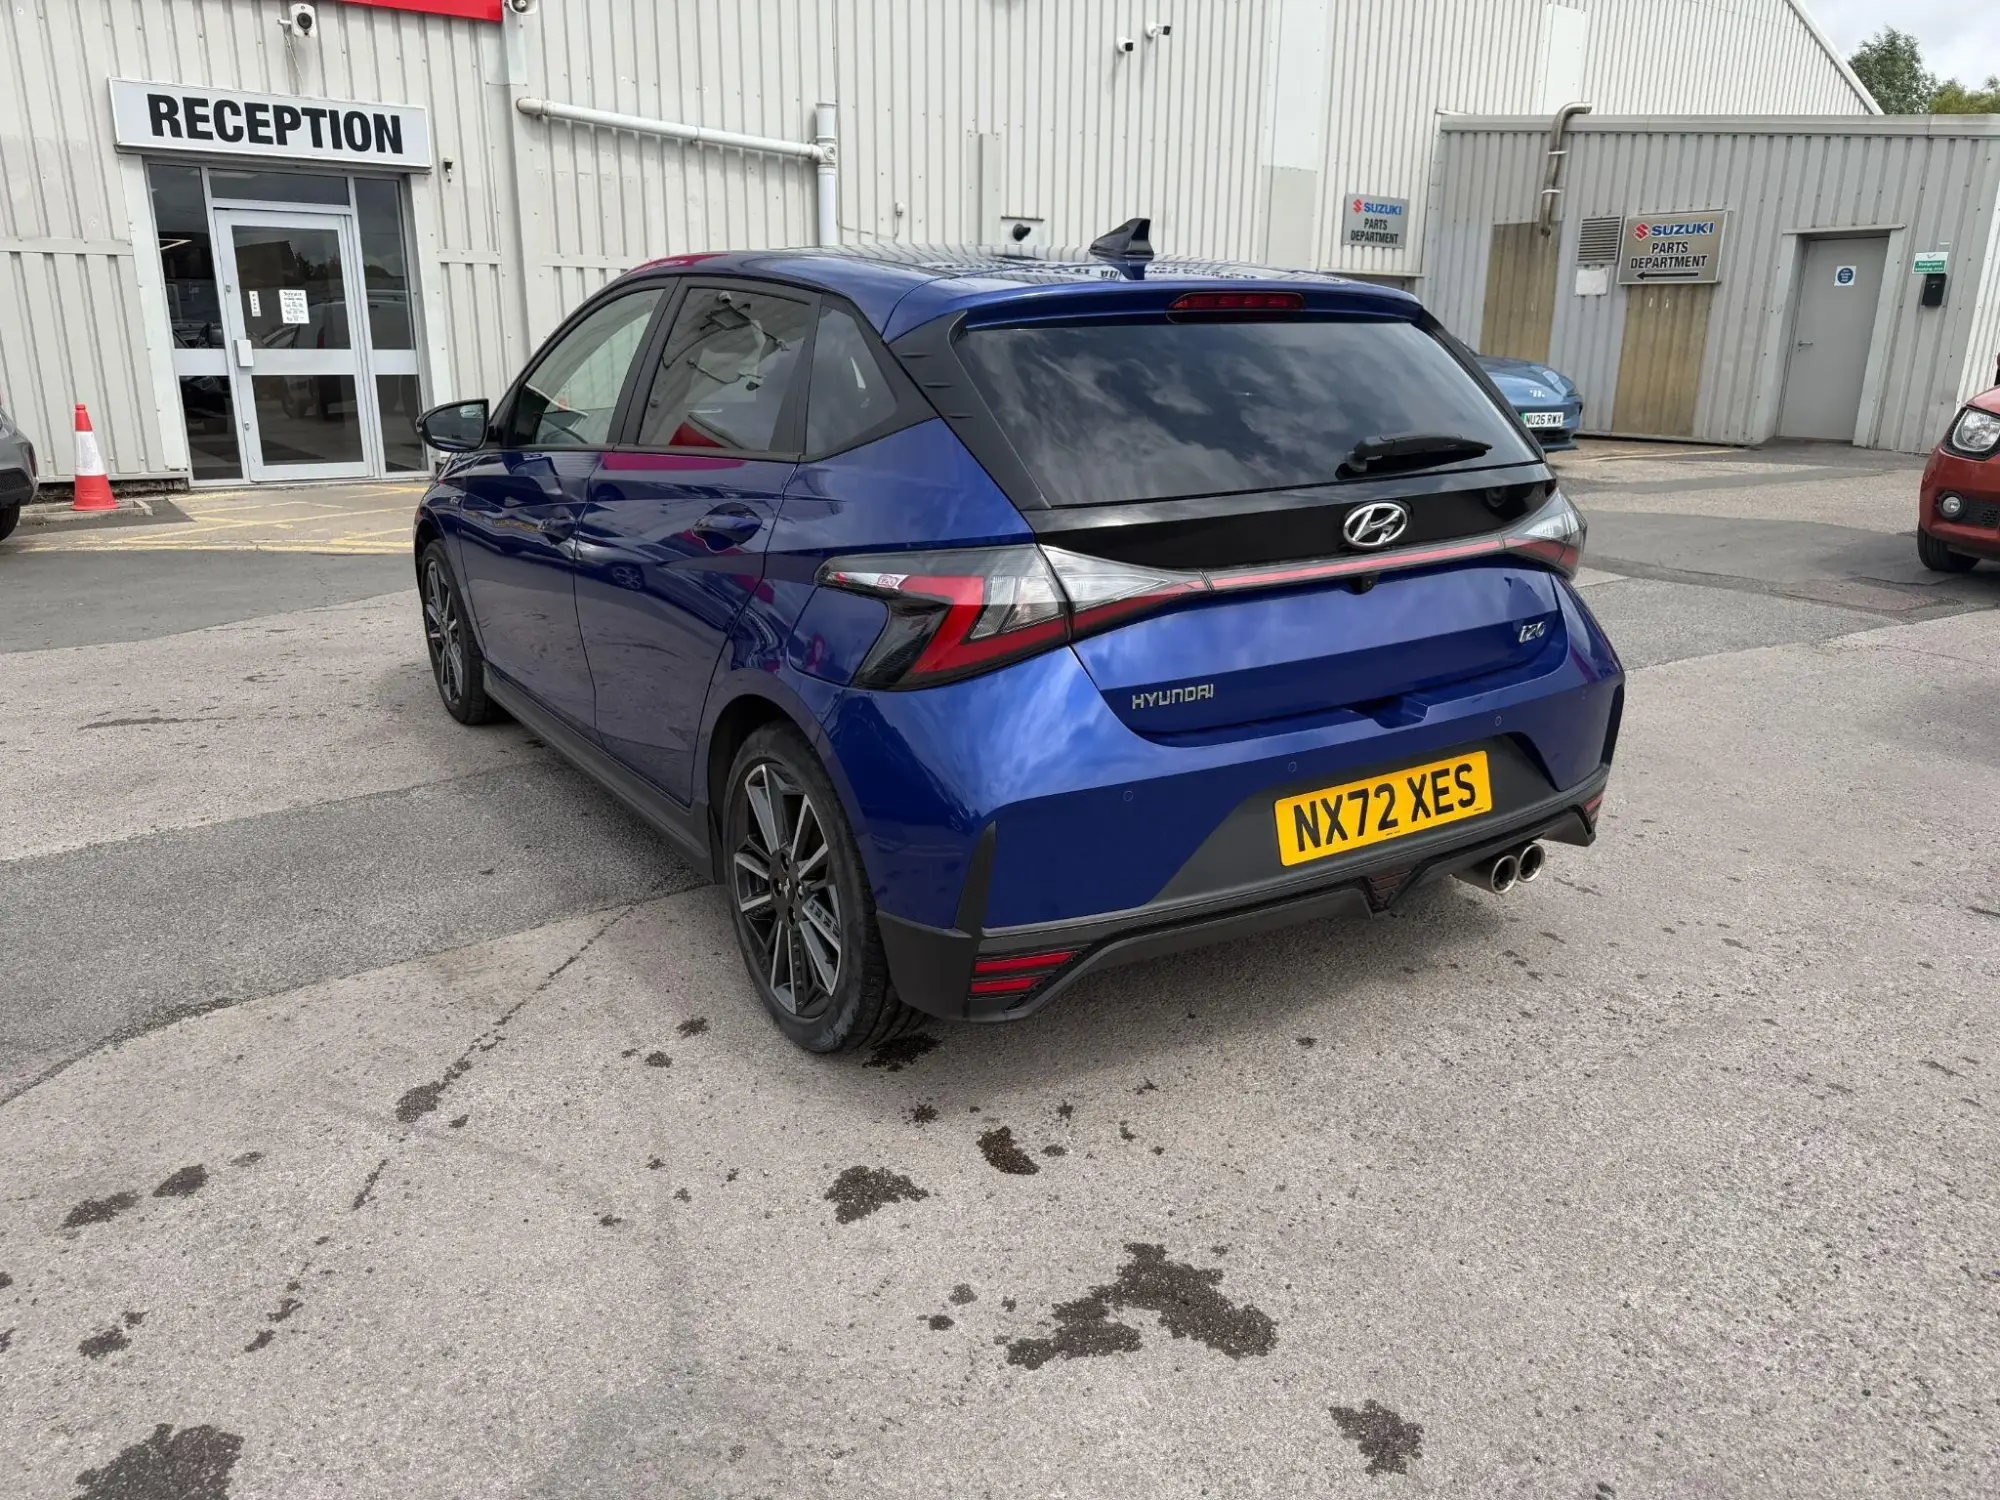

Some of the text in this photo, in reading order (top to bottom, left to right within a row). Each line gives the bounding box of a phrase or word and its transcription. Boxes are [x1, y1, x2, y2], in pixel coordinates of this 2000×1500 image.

[147, 93, 403, 154] RECEPTION
[1364, 202, 1402, 215] SUZUKI
[1364, 218, 1388, 230] PARTS
[1651, 223, 1714, 236] SUZUKI
[1350, 230, 1399, 244] DEPARTMENT
[1651, 241, 1688, 254] PARTS
[1630, 255, 1707, 269] DEPARTMENT
[1132, 684, 1214, 709] HYUNDAI
[1294, 763, 1476, 852] NX72 XES
